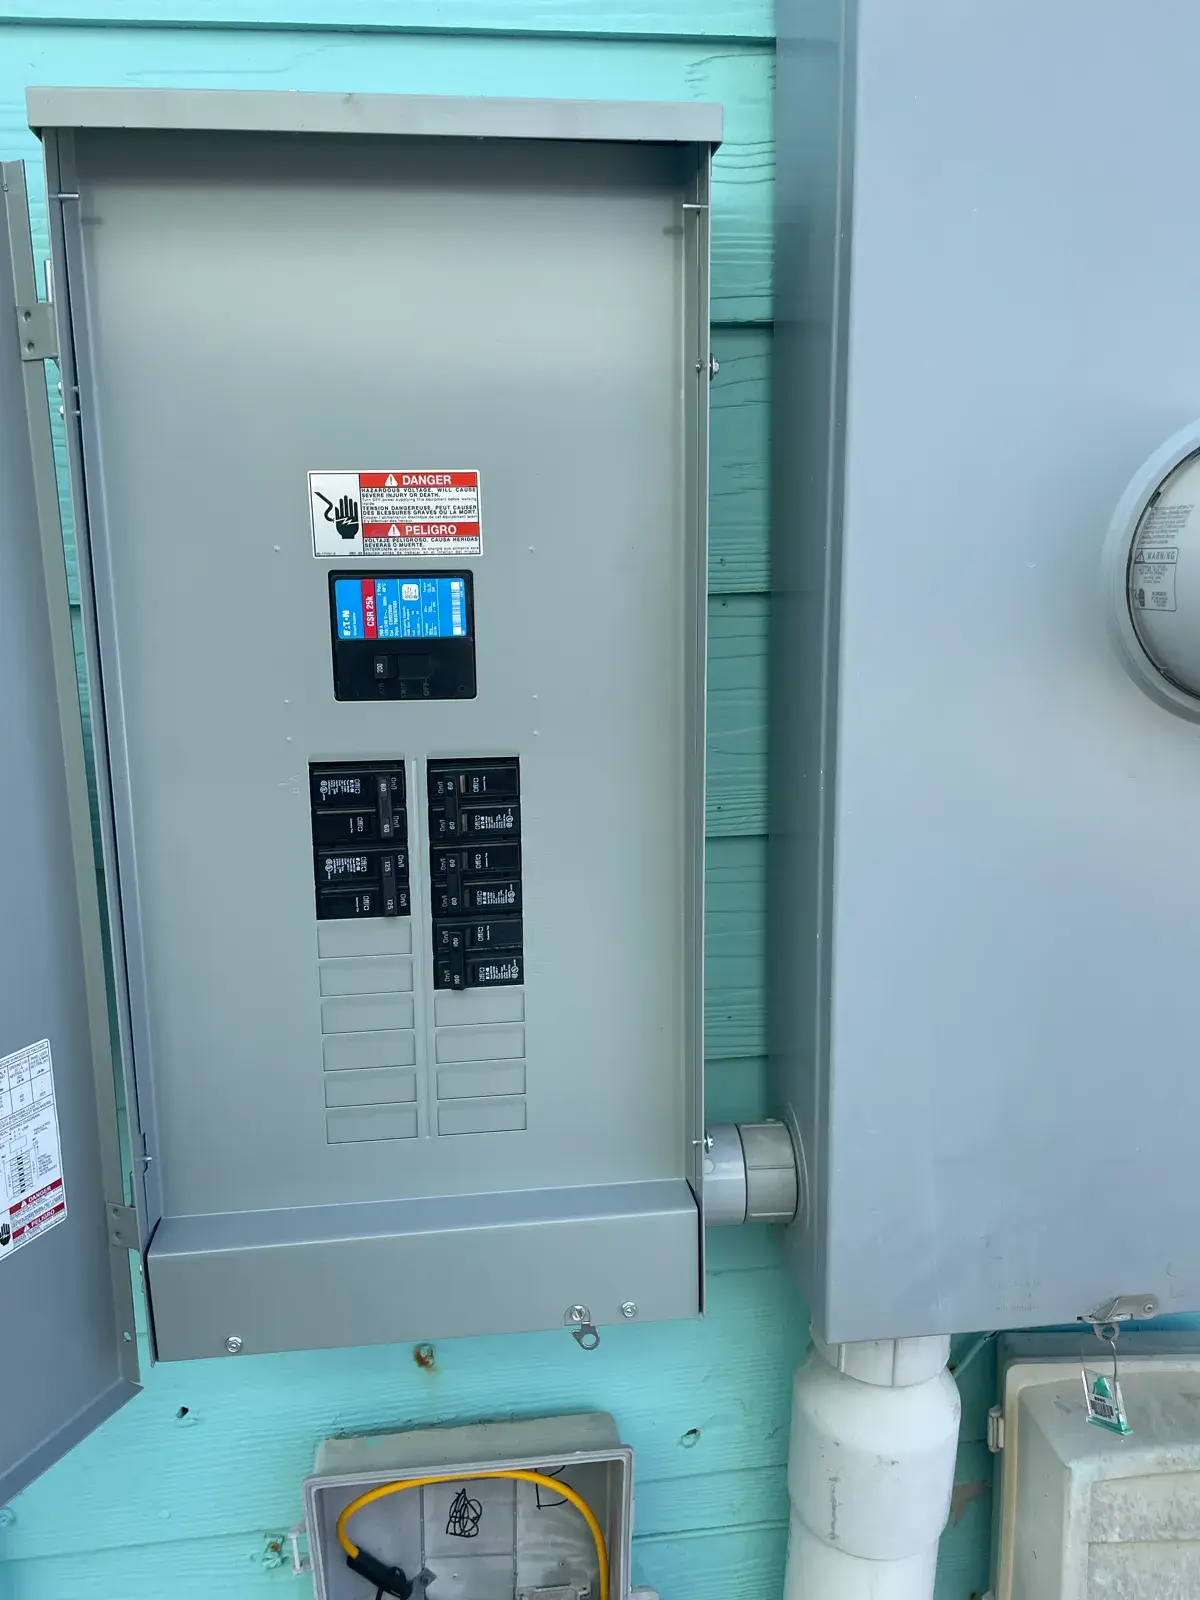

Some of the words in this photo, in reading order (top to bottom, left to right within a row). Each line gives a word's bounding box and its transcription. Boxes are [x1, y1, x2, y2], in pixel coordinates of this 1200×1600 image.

[402, 475, 452, 486] DANGER
[406, 525, 457, 535] PELIGRO
[1147, 551, 1175, 560] WARNING
[365, 595, 374, 610] 25k
[367, 611, 375, 627] CSR
[380, 783, 386, 792] 60
[447, 782, 454, 790] 60
[384, 824, 390, 832] 60
[449, 859, 456, 867] 60
[28, 1186, 52, 1202] DANGER
[31, 1209, 55, 1227] PELIGRO
